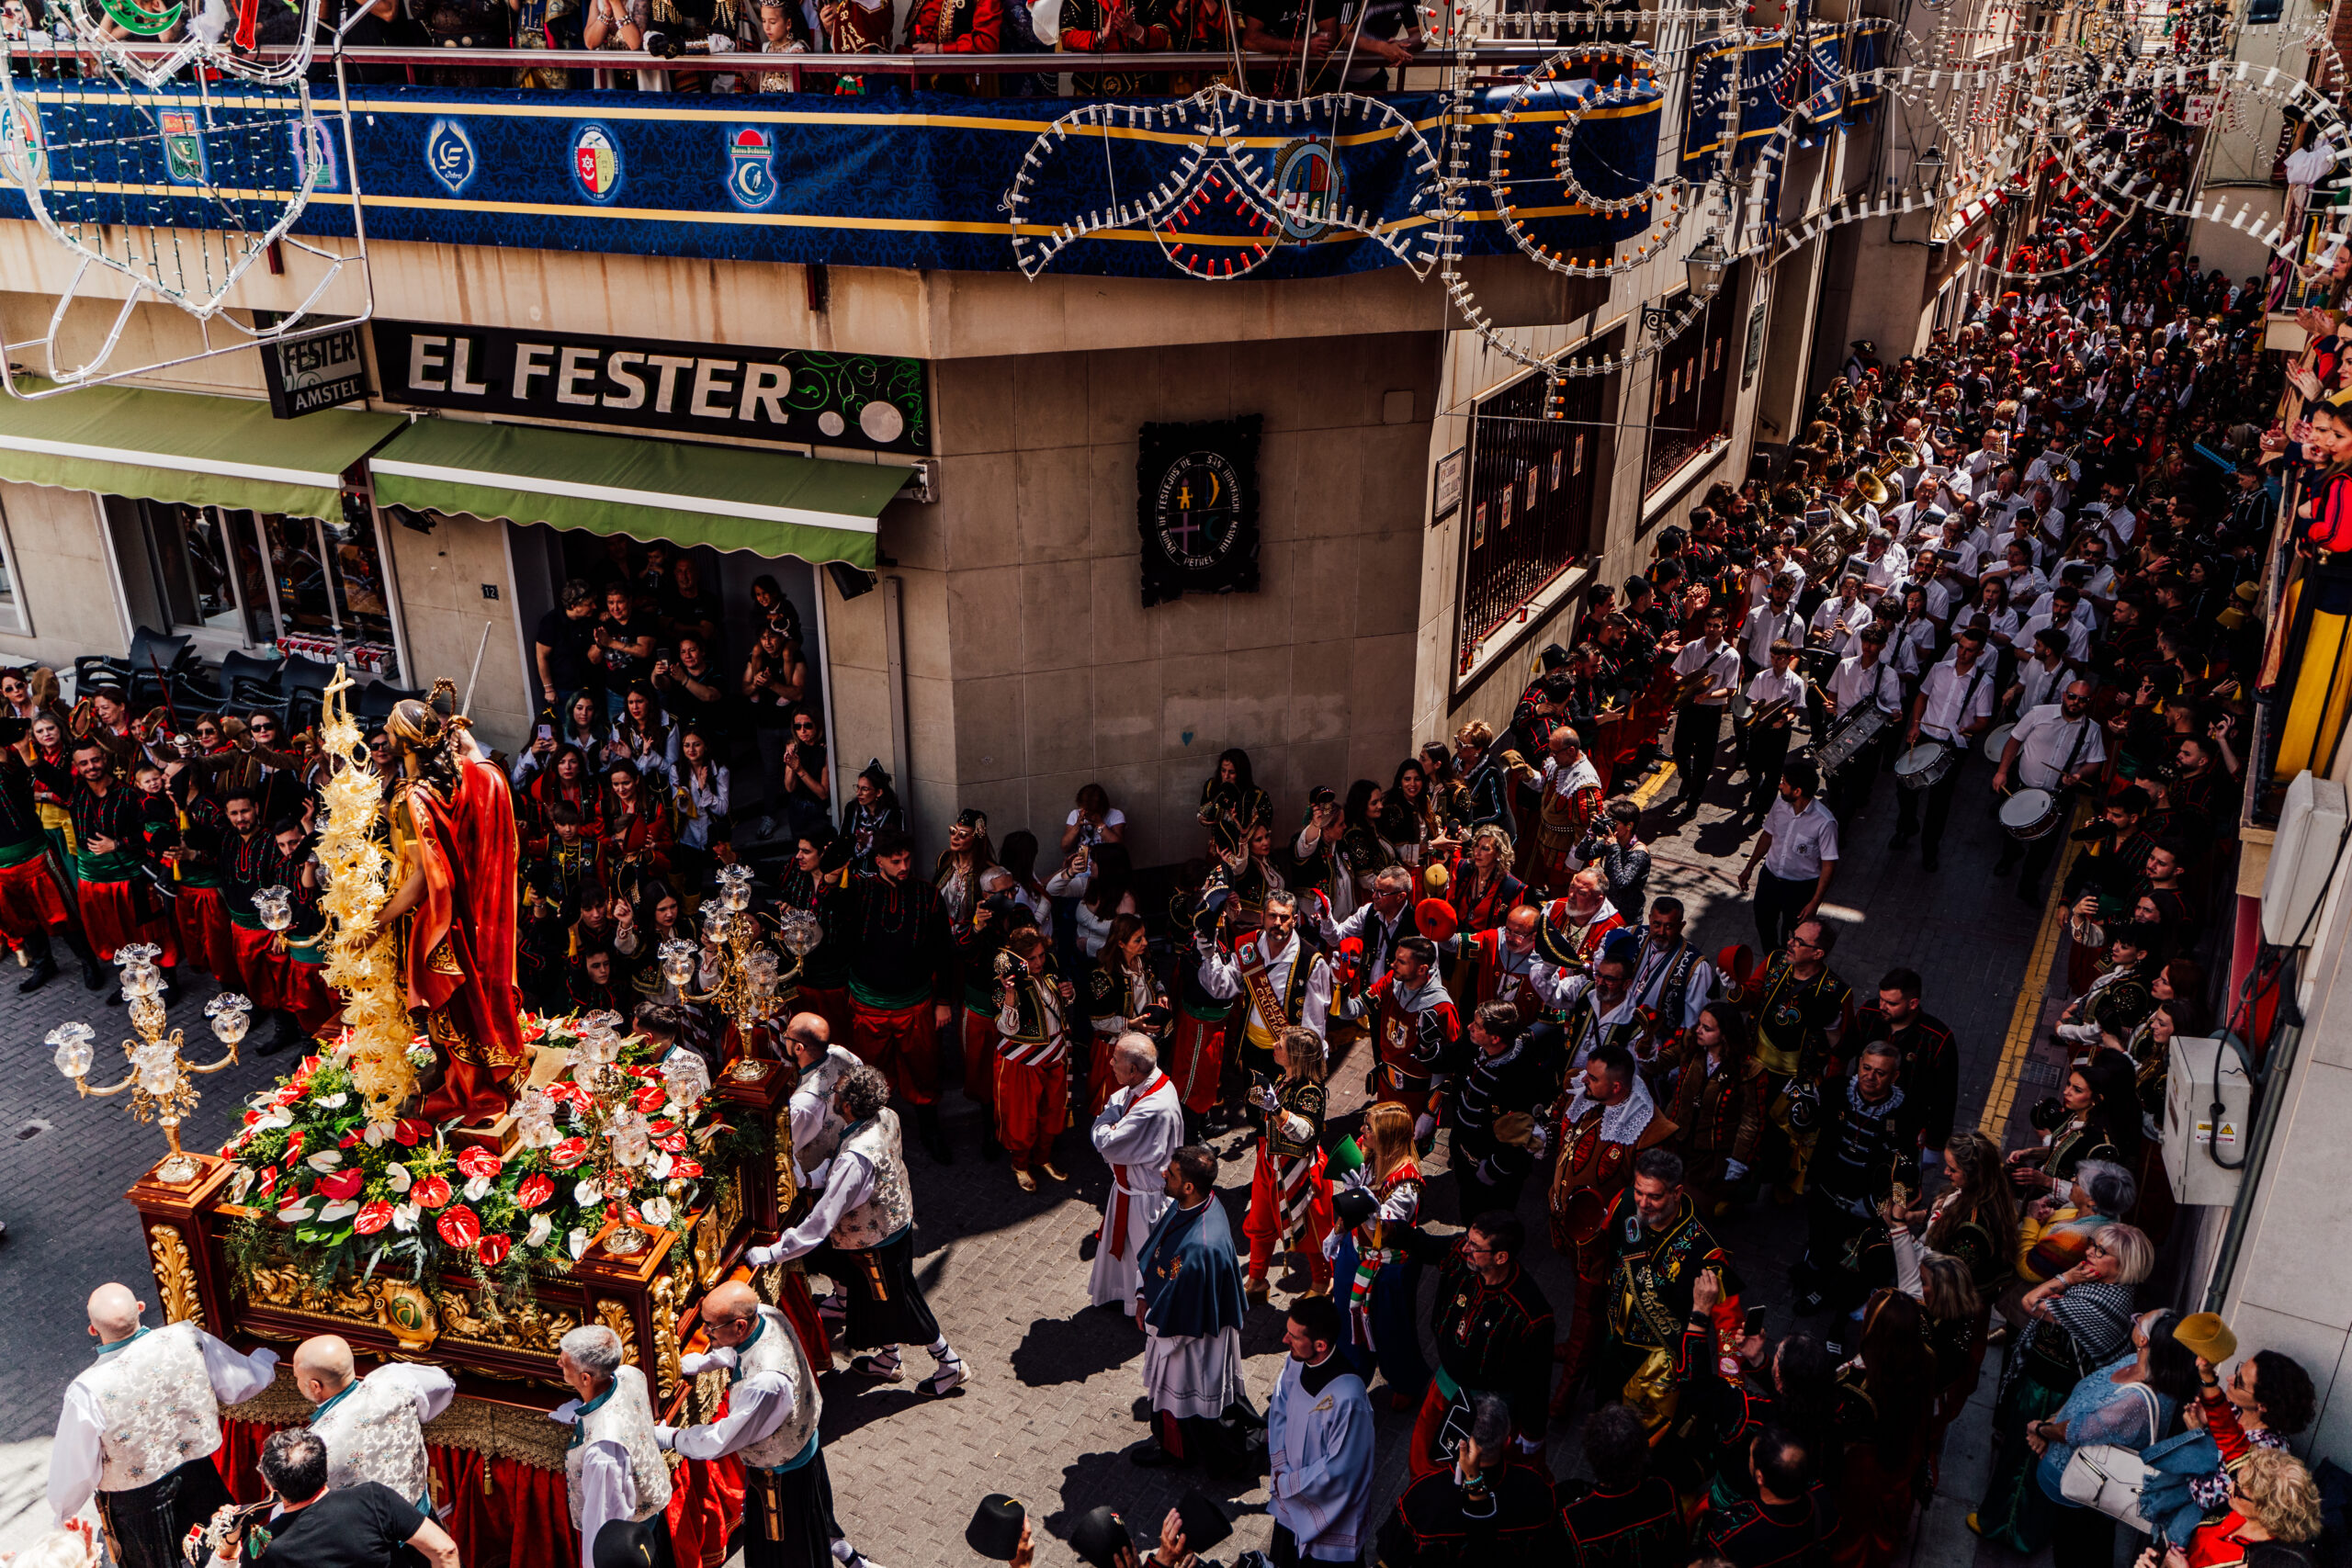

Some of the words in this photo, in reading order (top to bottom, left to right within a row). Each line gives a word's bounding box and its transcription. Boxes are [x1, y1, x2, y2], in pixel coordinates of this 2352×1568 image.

[283, 329, 356, 377] FESTER
[295, 379, 360, 412] AMSTEL
[408, 333, 487, 395] EL
[512, 343, 791, 424] FESTER
[484, 587, 496, 598] 12
[1256, 987, 1284, 1039] CRISTIAN
[1259, 975, 1288, 1026] EMBAJA
